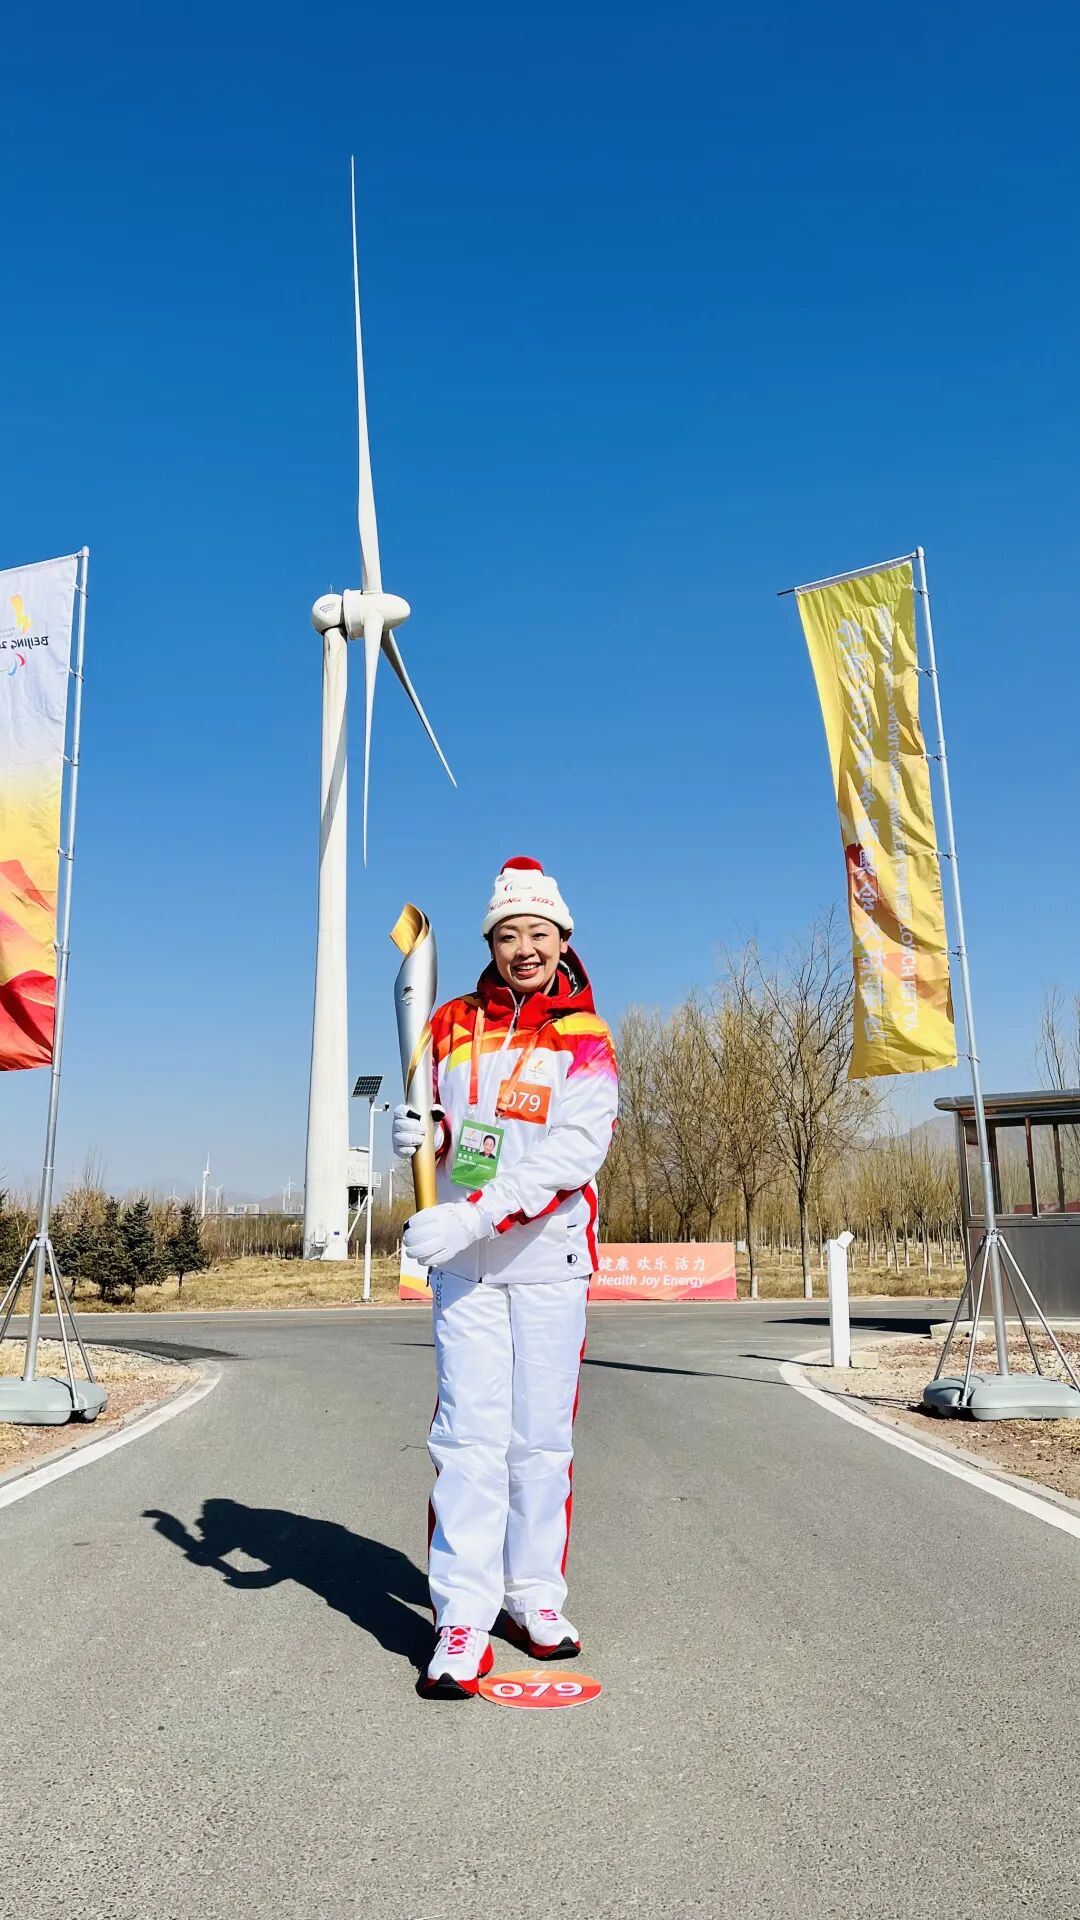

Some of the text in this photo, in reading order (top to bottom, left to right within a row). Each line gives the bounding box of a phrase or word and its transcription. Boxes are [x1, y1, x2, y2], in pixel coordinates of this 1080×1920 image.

[530, 896, 555, 907] 2022
[599, 1256, 706, 1271] 健康 欢乐 活力
[598, 1274, 706, 1289] Health Joy Energy
[492, 1682, 583, 1698] 079
